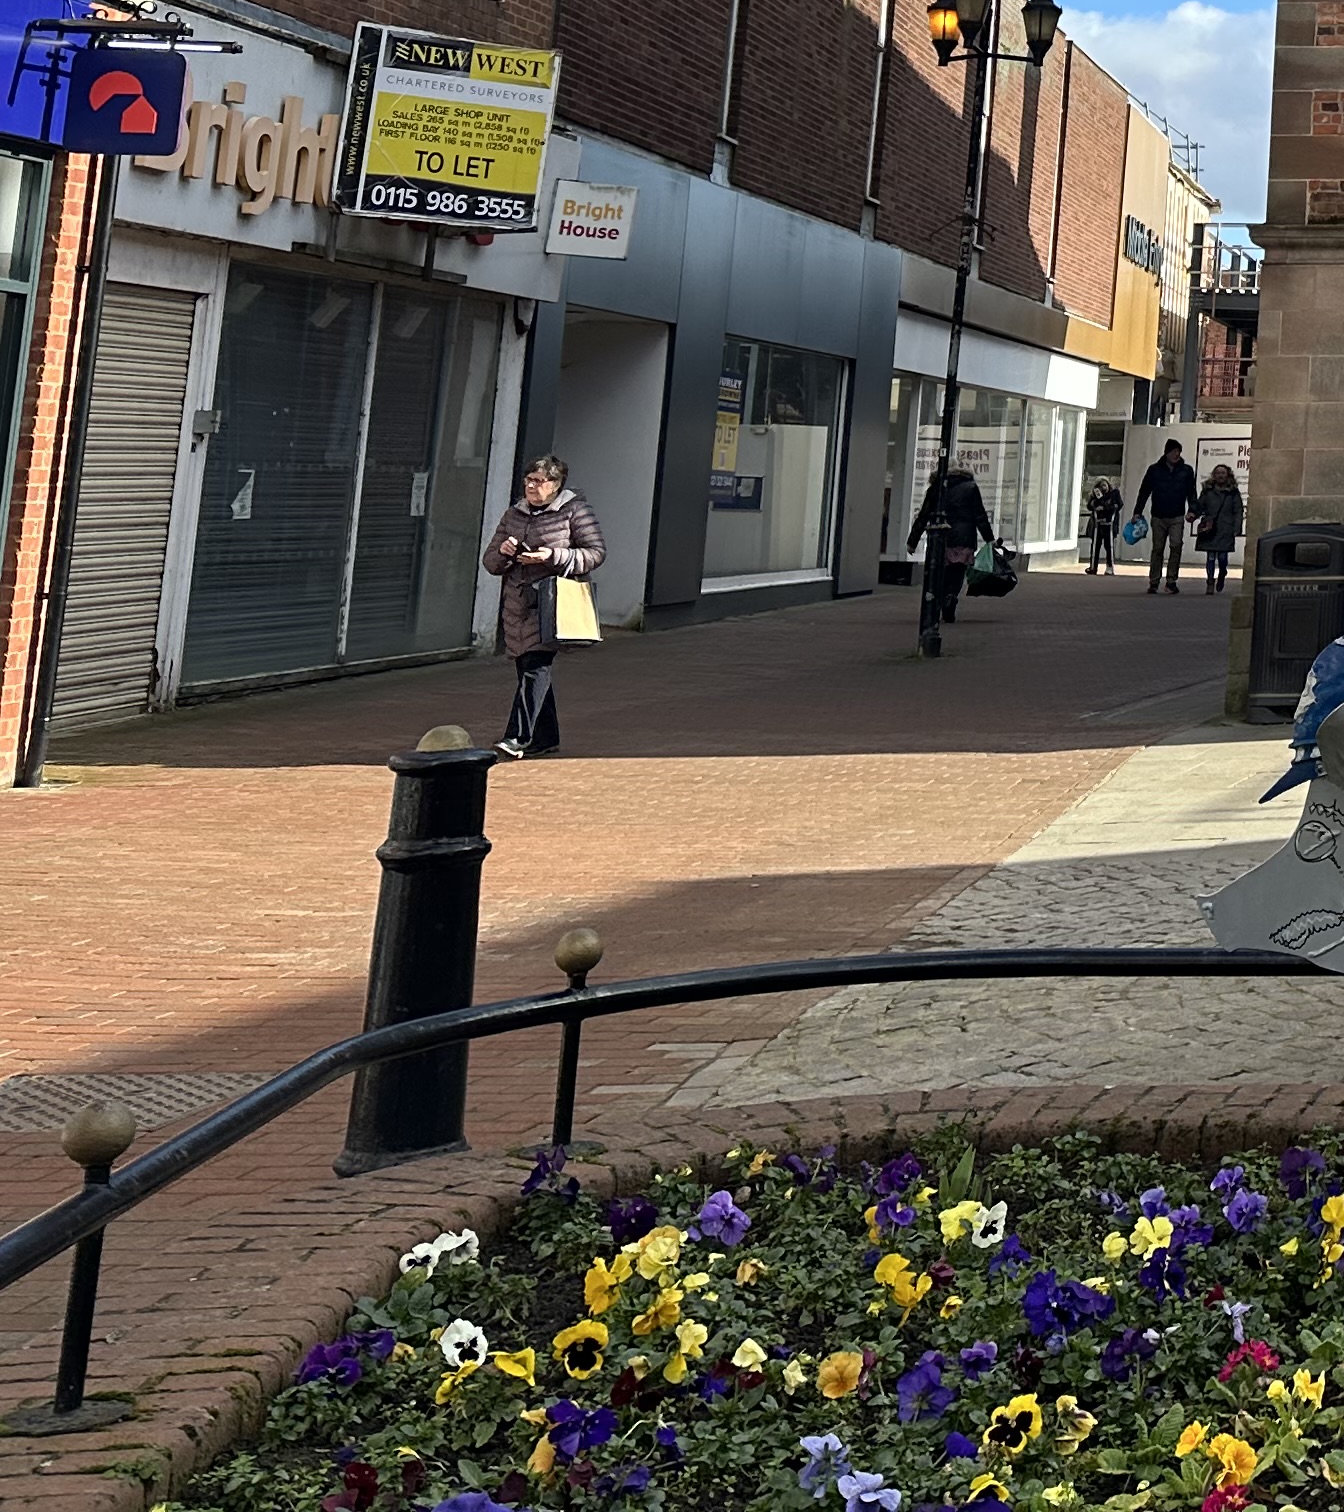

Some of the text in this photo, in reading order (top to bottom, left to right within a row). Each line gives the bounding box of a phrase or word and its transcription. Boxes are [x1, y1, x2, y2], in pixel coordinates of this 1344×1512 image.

[410, 43, 544, 79] NEW WEST
[386, 74, 544, 104] CHARTERED SURVEYORS
[346, 62, 371, 176] www.newwest.co.uk
[392, 110, 423, 122] SALES
[448, 119, 458, 127] sq
[506, 126, 516, 134] sq
[414, 103, 511, 124] LARGE SHOP UNIT
[134, 71, 339, 215] right
[377, 119, 418, 131] LOADING
[423, 124, 440, 133] BAY
[517, 138, 527, 146] sq
[379, 128, 407, 139] FIRST
[410, 132, 440, 143] FLOOR
[460, 139, 471, 148] sq
[513, 145, 523, 154] sq
[415, 150, 495, 179] TO LET
[371, 185, 525, 219] 0115 986 3555
[562, 199, 624, 221] Bright
[559, 219, 620, 240] House
